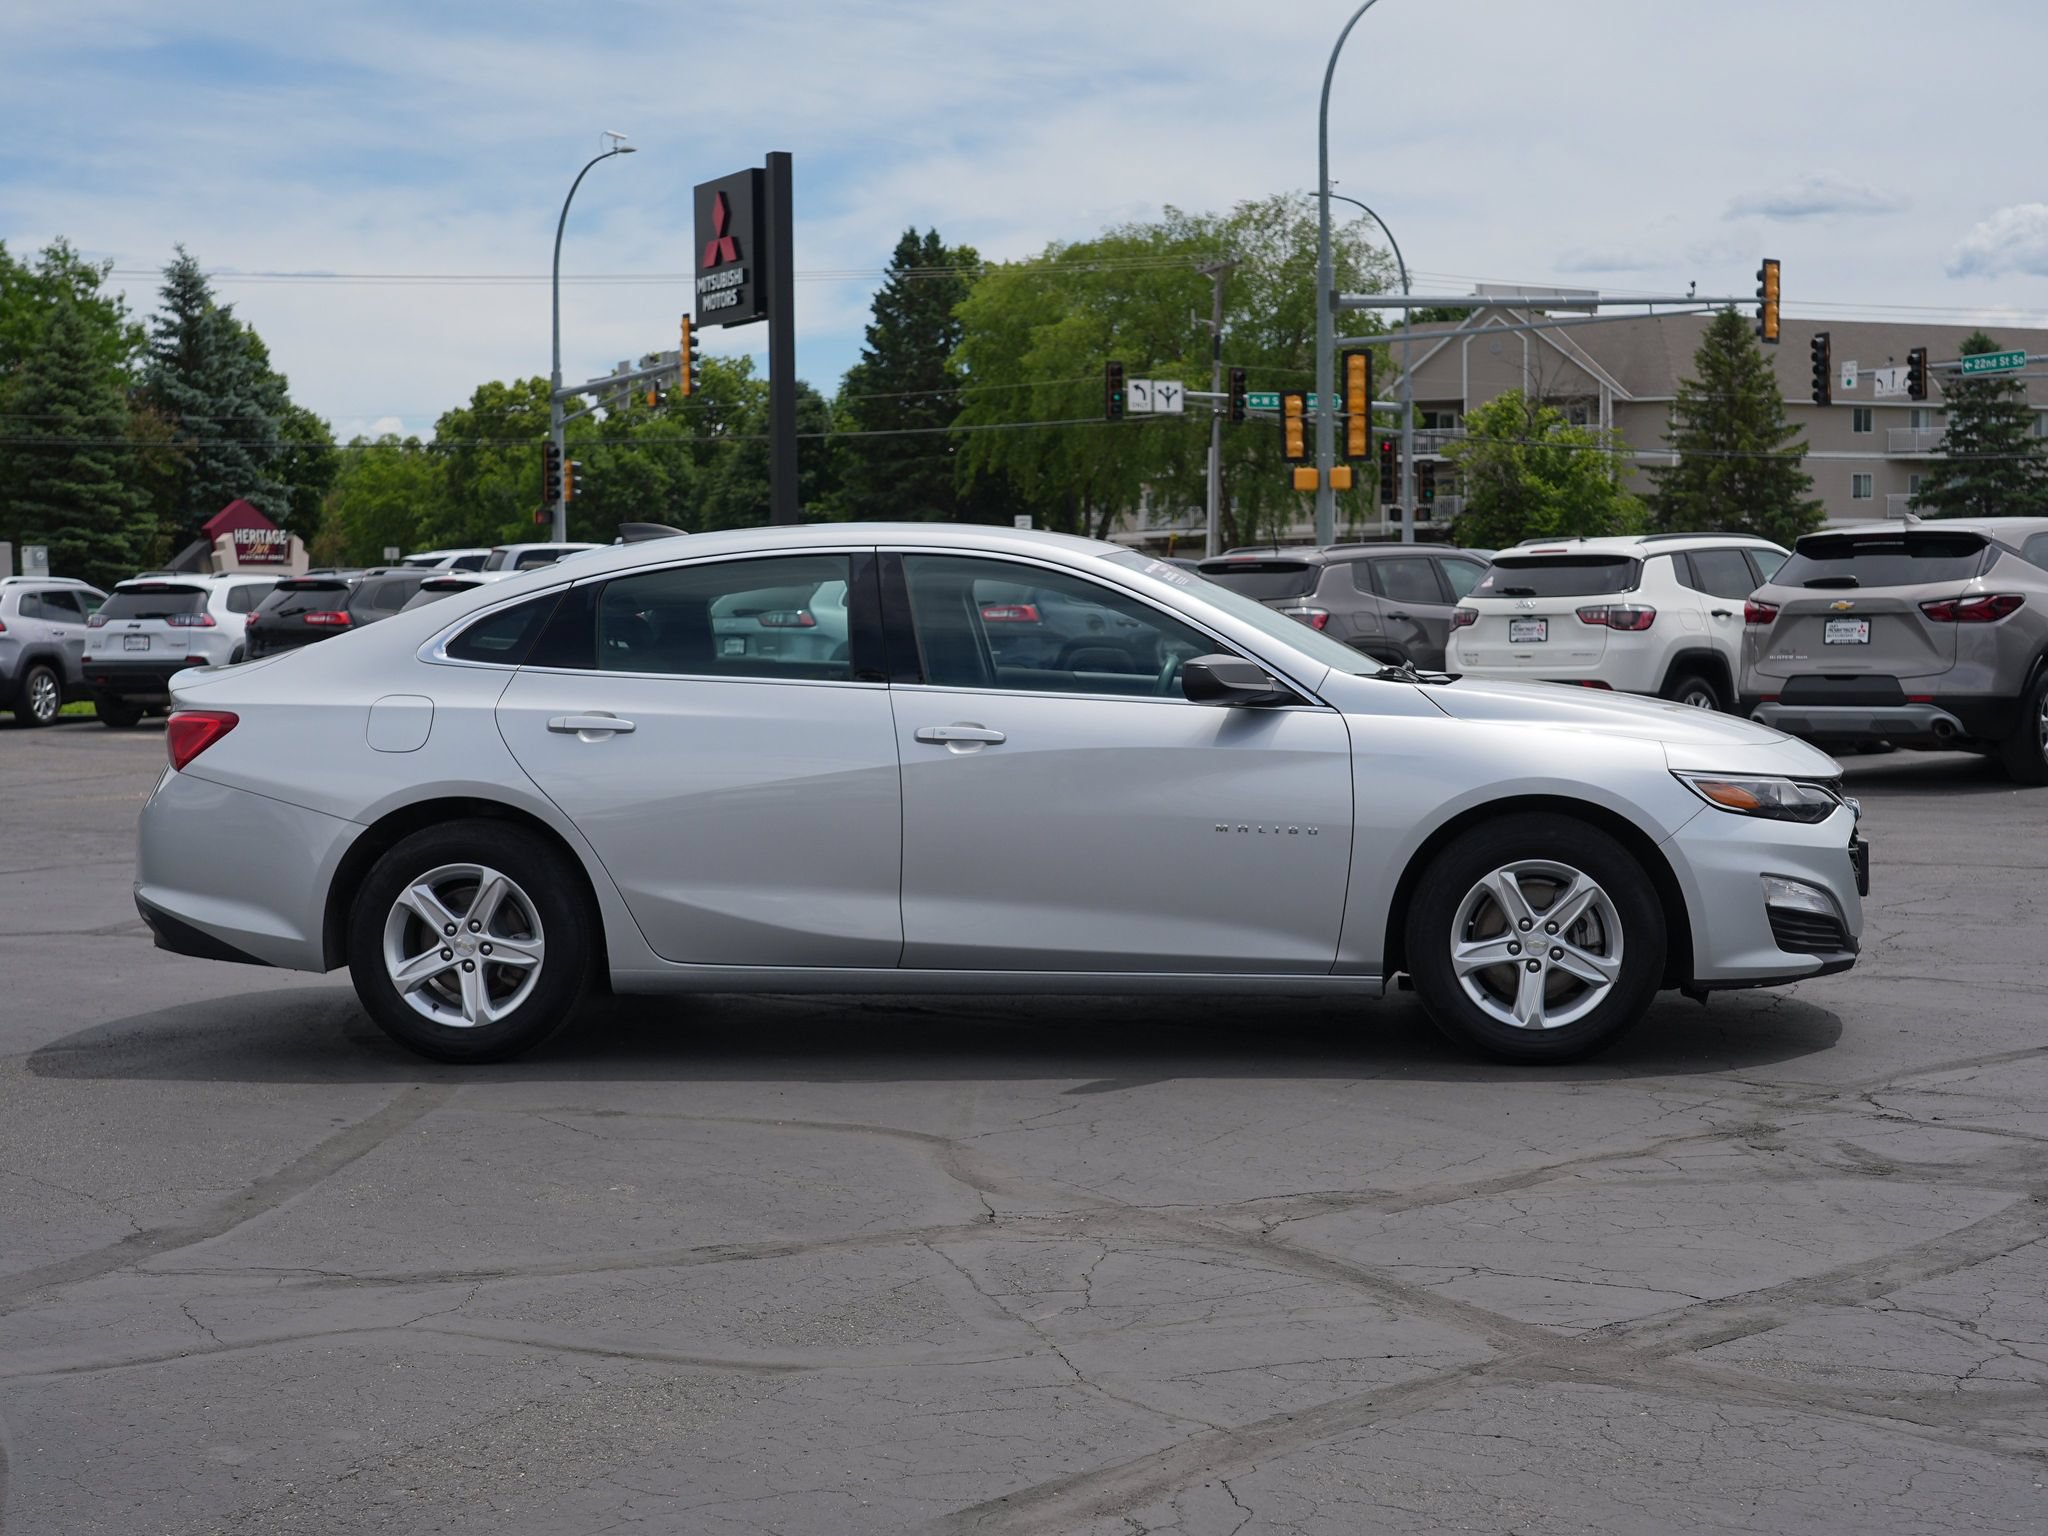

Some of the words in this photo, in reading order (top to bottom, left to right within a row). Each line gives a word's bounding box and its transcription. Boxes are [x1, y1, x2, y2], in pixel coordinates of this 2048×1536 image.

[697, 267, 744, 294] MITSUBISHI
[702, 288, 738, 312] MOTORS
[1974, 358, 1997, 369] 22nd
[2000, 356, 2010, 366] St
[234, 528, 288, 545] HERITAGE
[1215, 824, 1319, 836] MALIBU
